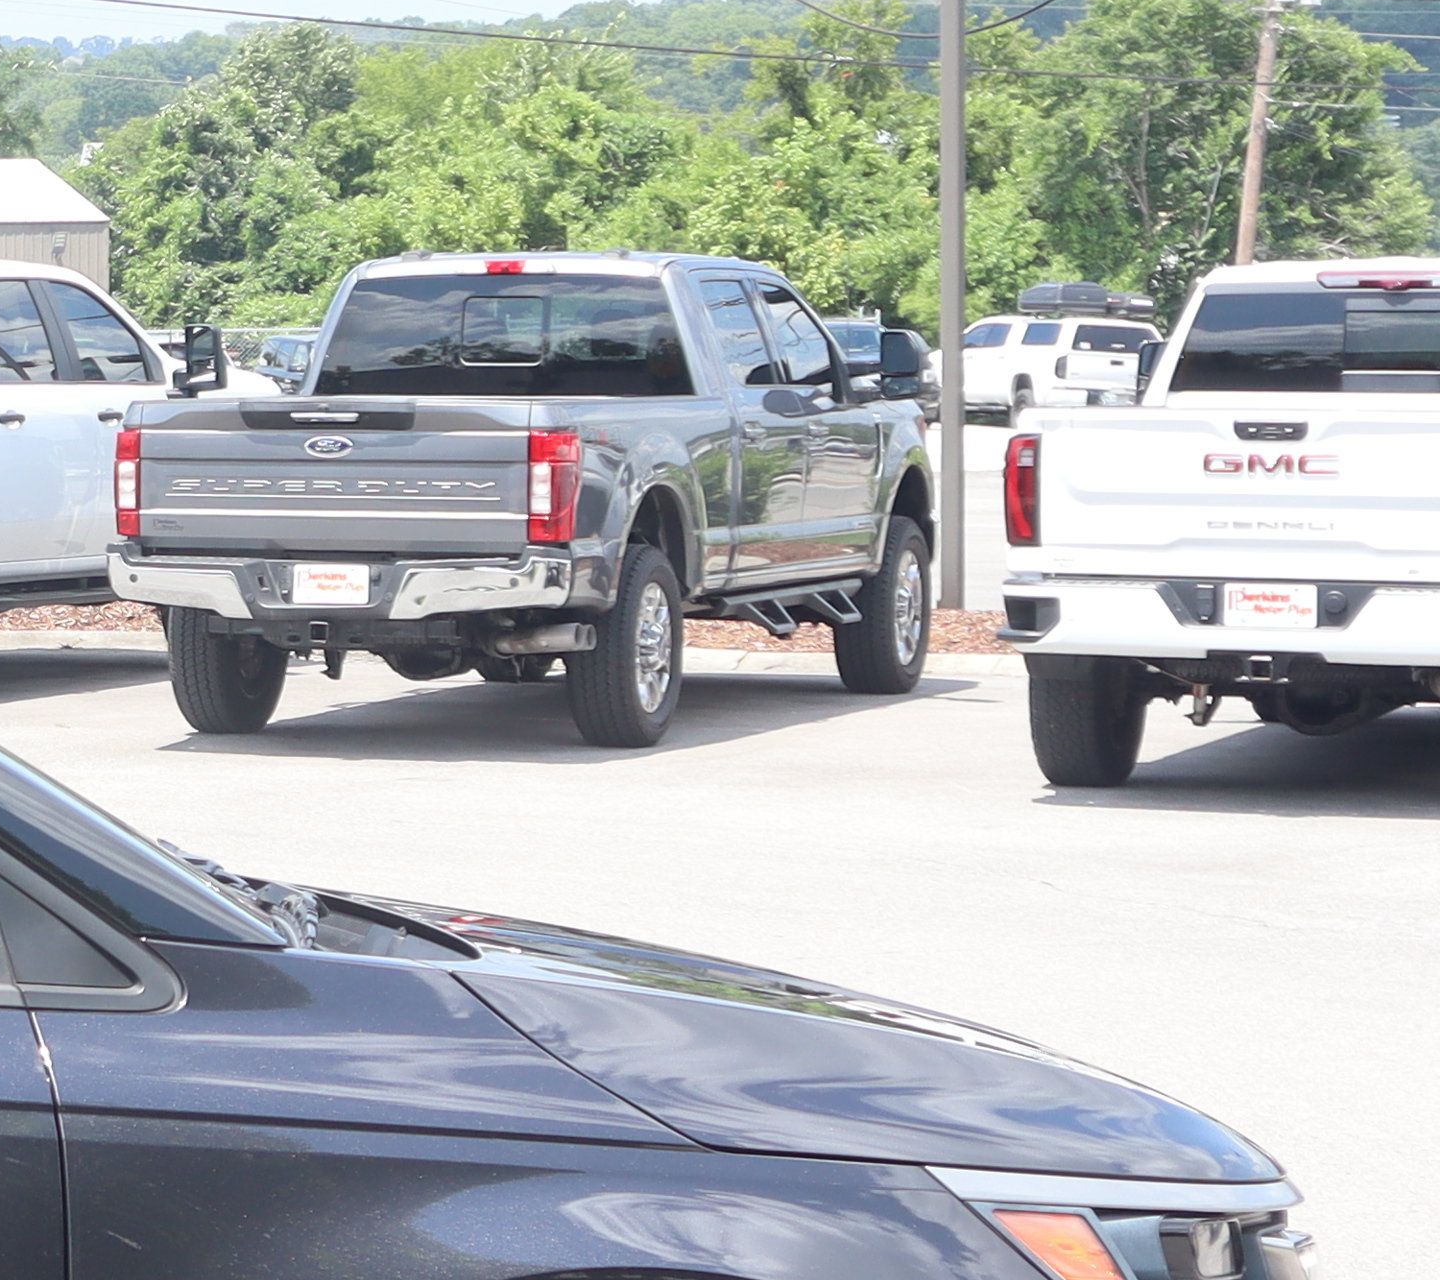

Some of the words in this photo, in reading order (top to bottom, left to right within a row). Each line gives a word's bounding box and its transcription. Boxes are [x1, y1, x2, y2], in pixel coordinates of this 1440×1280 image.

[1203, 454, 1340, 478] GMC
[172, 479, 343, 493] SUPER
[357, 480, 496, 494] DUTY
[1206, 521, 1335, 531] DENALI
